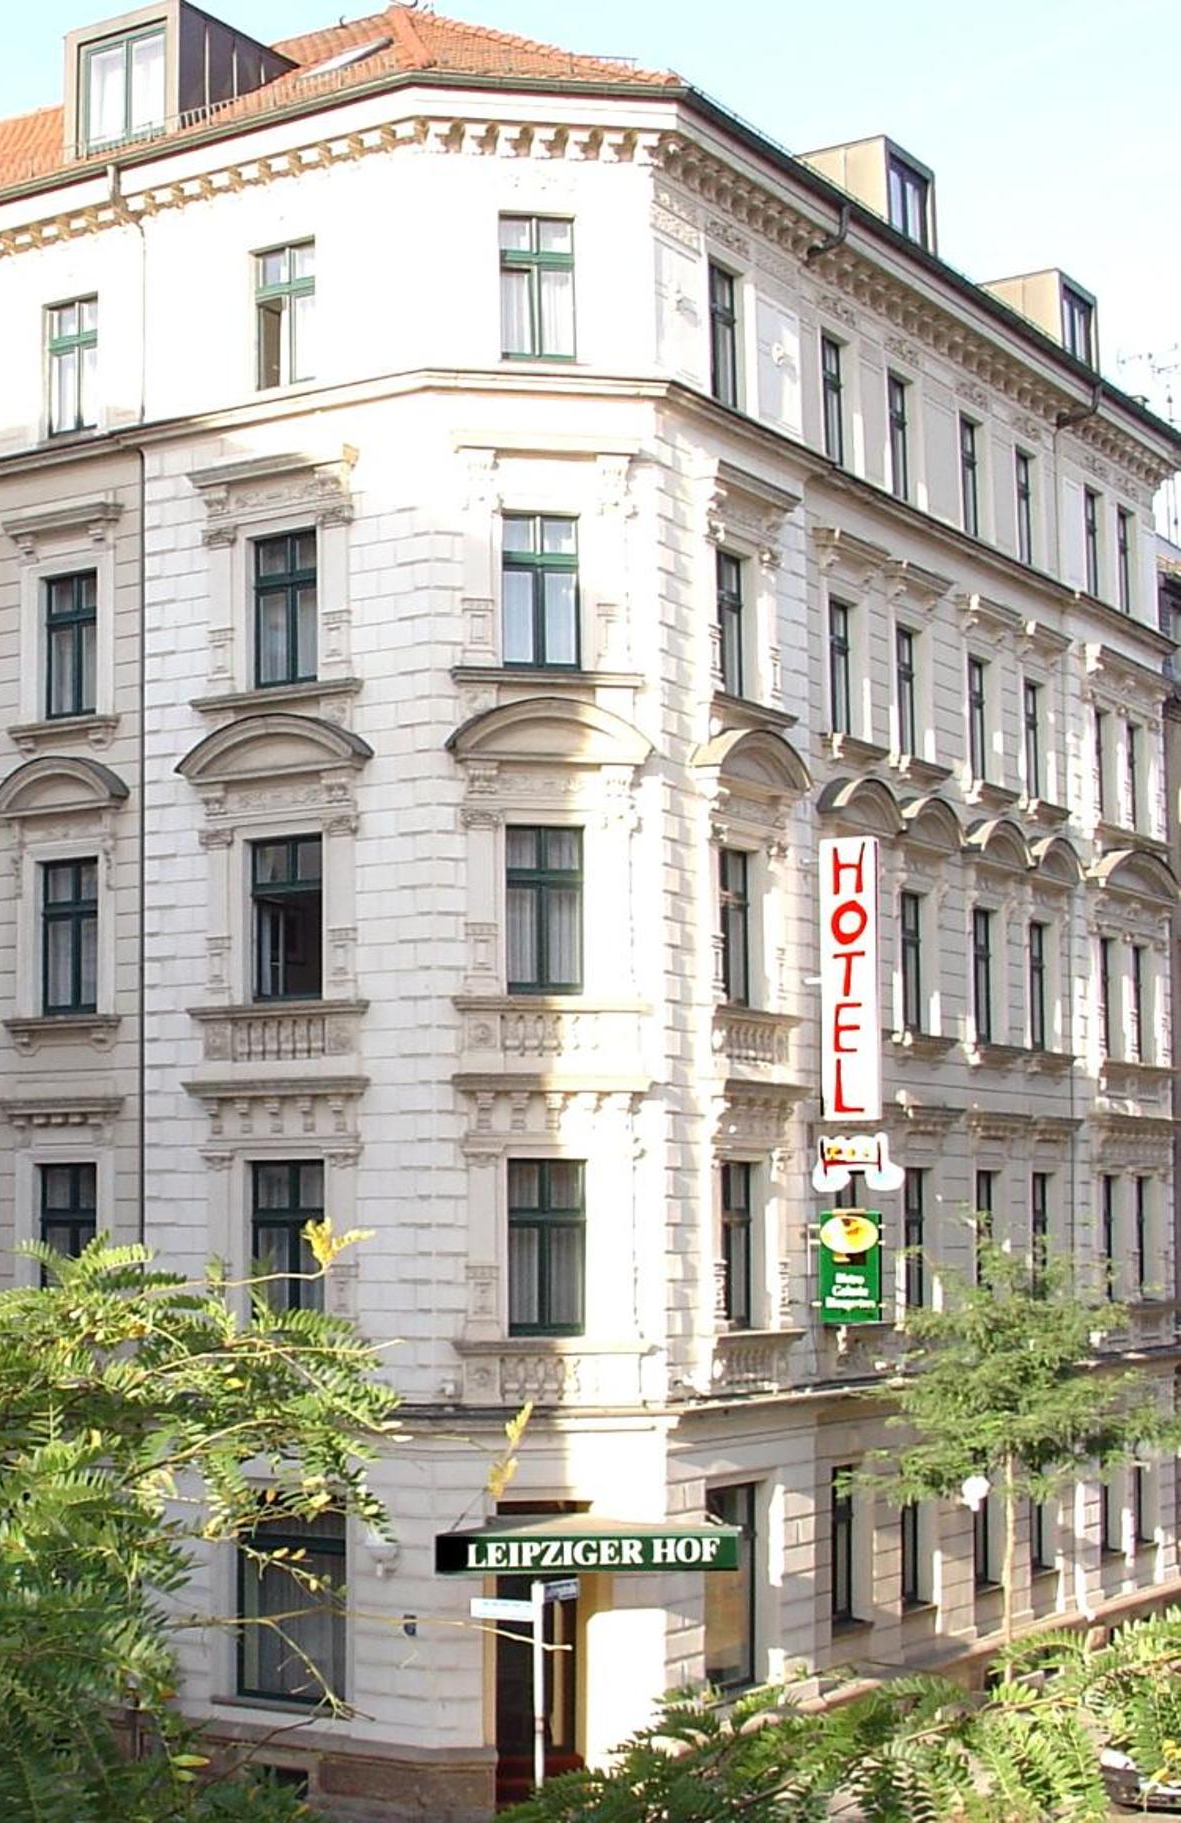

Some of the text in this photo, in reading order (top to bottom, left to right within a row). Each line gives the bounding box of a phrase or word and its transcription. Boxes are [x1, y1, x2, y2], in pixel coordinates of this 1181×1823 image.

[830, 841, 868, 1113] HOTEL
[467, 1537, 721, 1568] LEIPZIGER HOF
